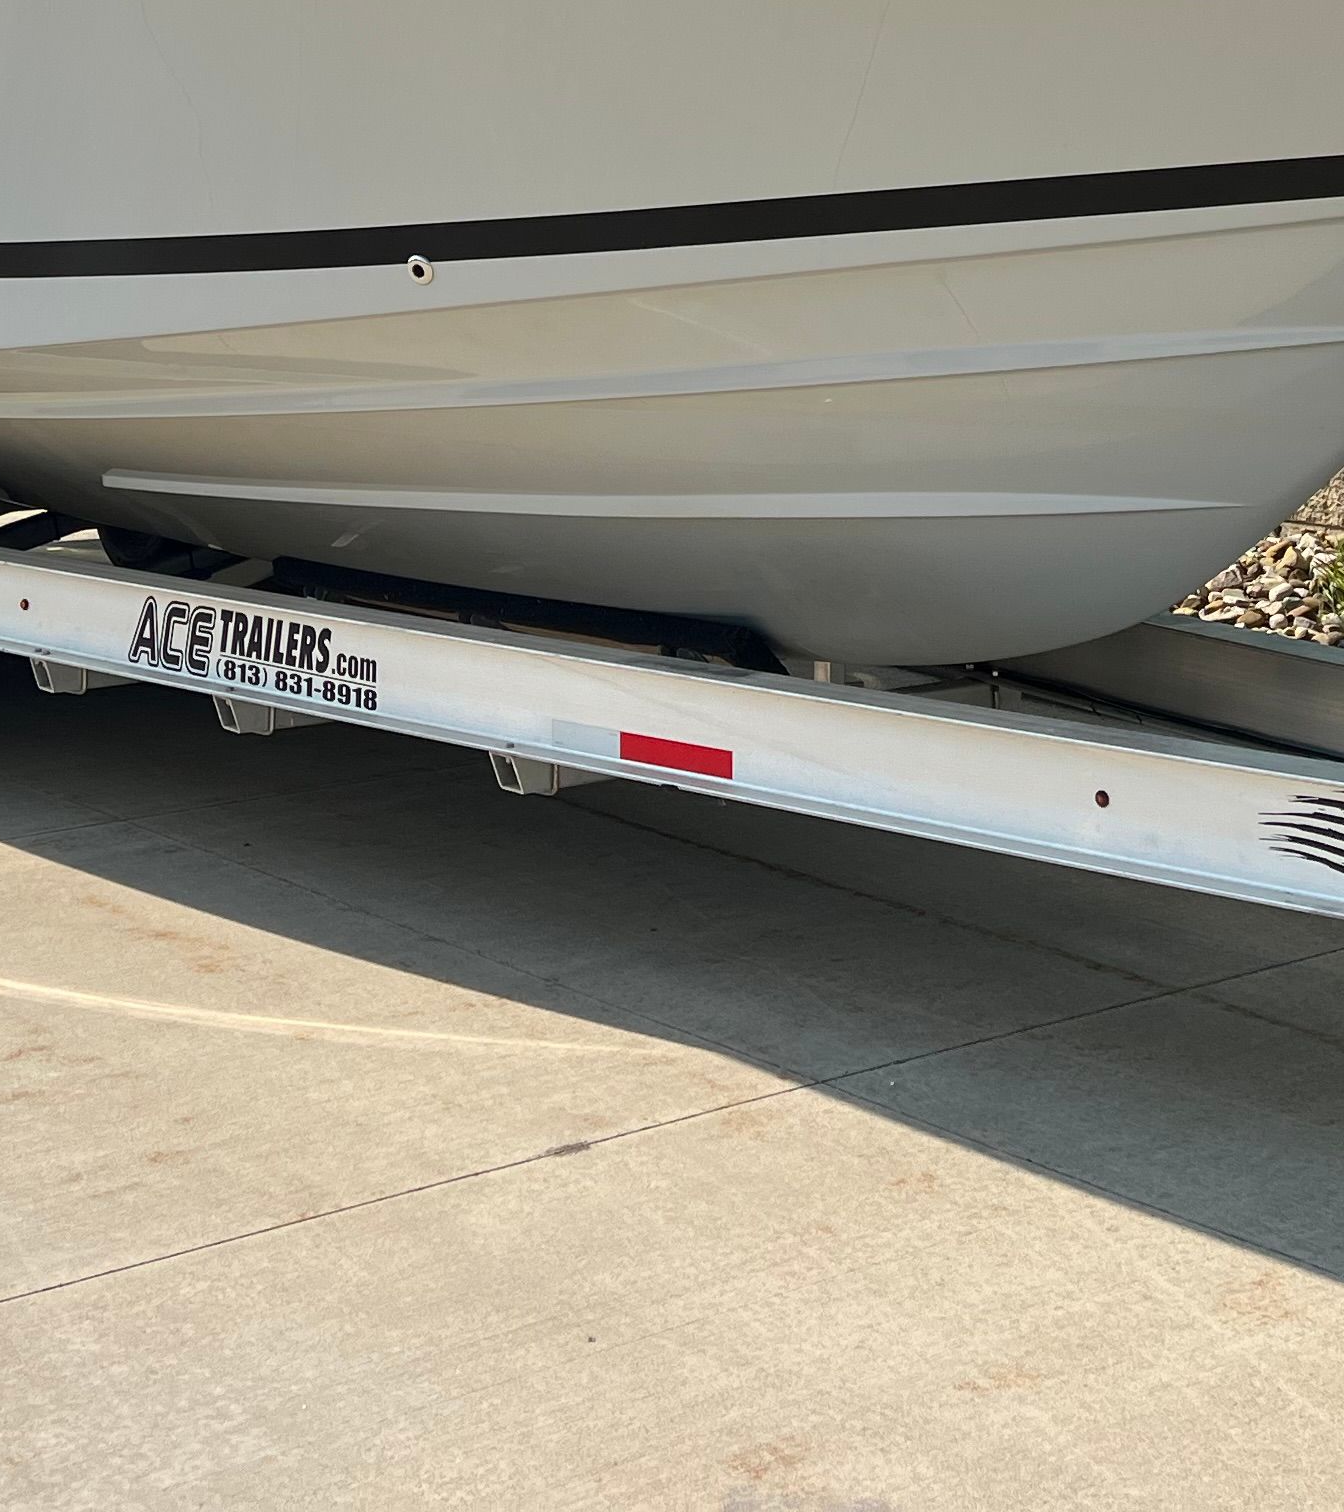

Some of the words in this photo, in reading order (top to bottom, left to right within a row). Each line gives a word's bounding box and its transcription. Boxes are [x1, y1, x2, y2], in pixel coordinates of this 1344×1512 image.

[128, 595, 216, 677] ACE
[219, 609, 378, 683] TRAILERS.com
[216, 658, 268, 689] (813)
[274, 670, 378, 711] 831-8918
